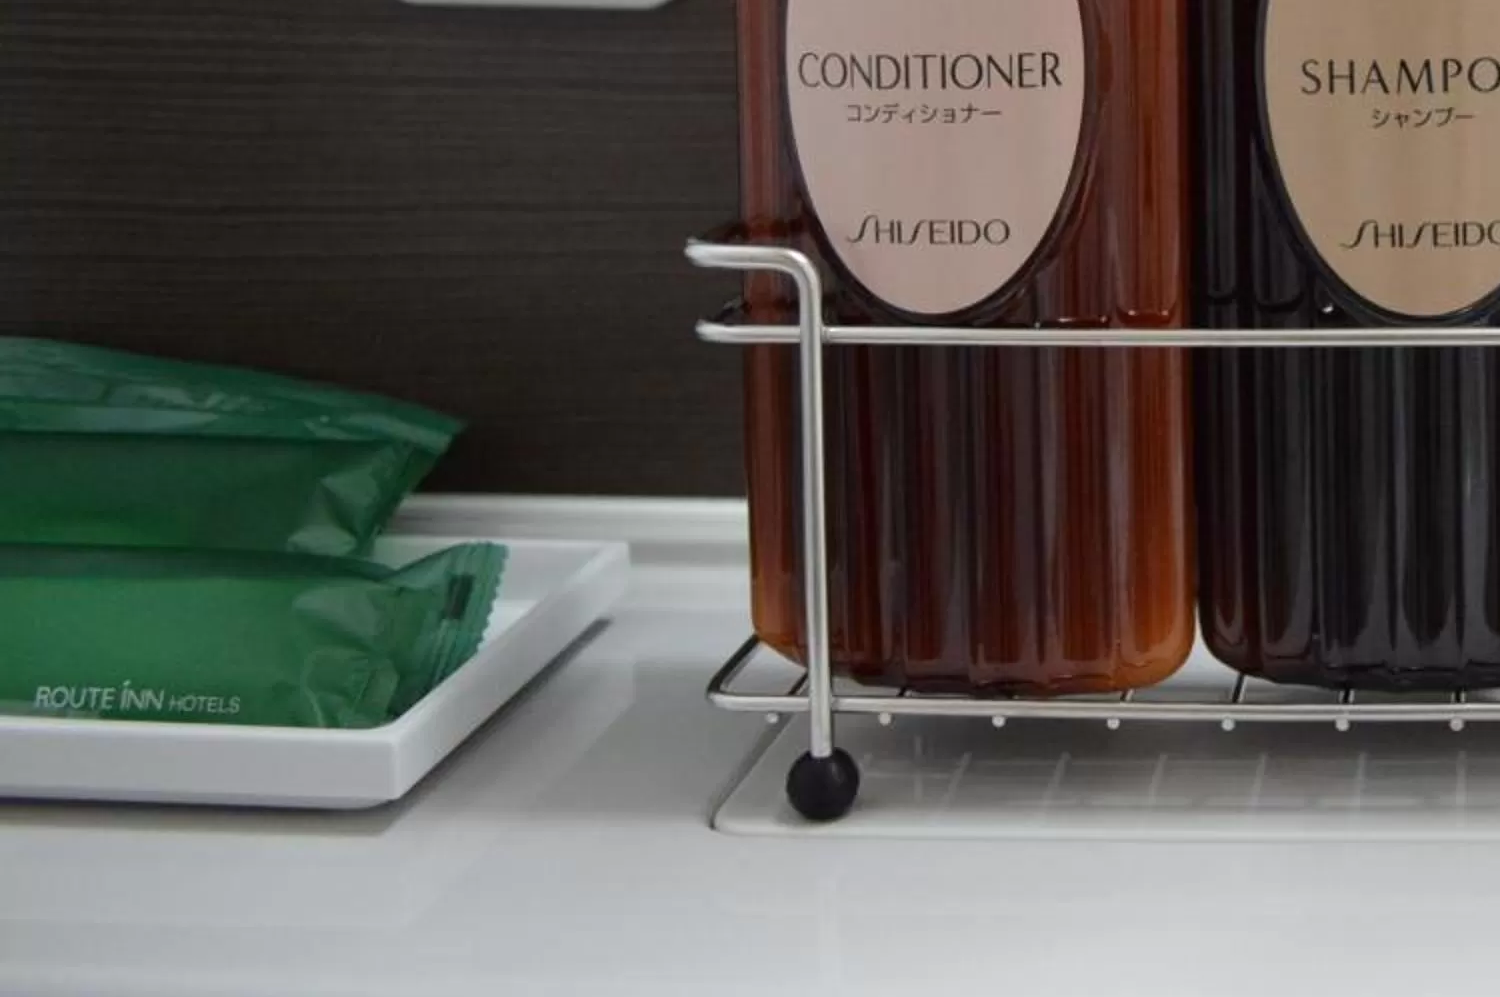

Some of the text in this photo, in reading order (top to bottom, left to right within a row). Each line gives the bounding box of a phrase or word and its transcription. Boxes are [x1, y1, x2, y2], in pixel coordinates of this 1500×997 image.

[798, 51, 1063, 91] CONDITIONER
[847, 102, 1003, 124] コンディショナー
[1371, 106, 1476, 130] シャンプー
[846, 214, 1011, 246] SHISEIDO
[34, 686, 116, 709] ROUTE
[168, 694, 241, 714] HOTELS
